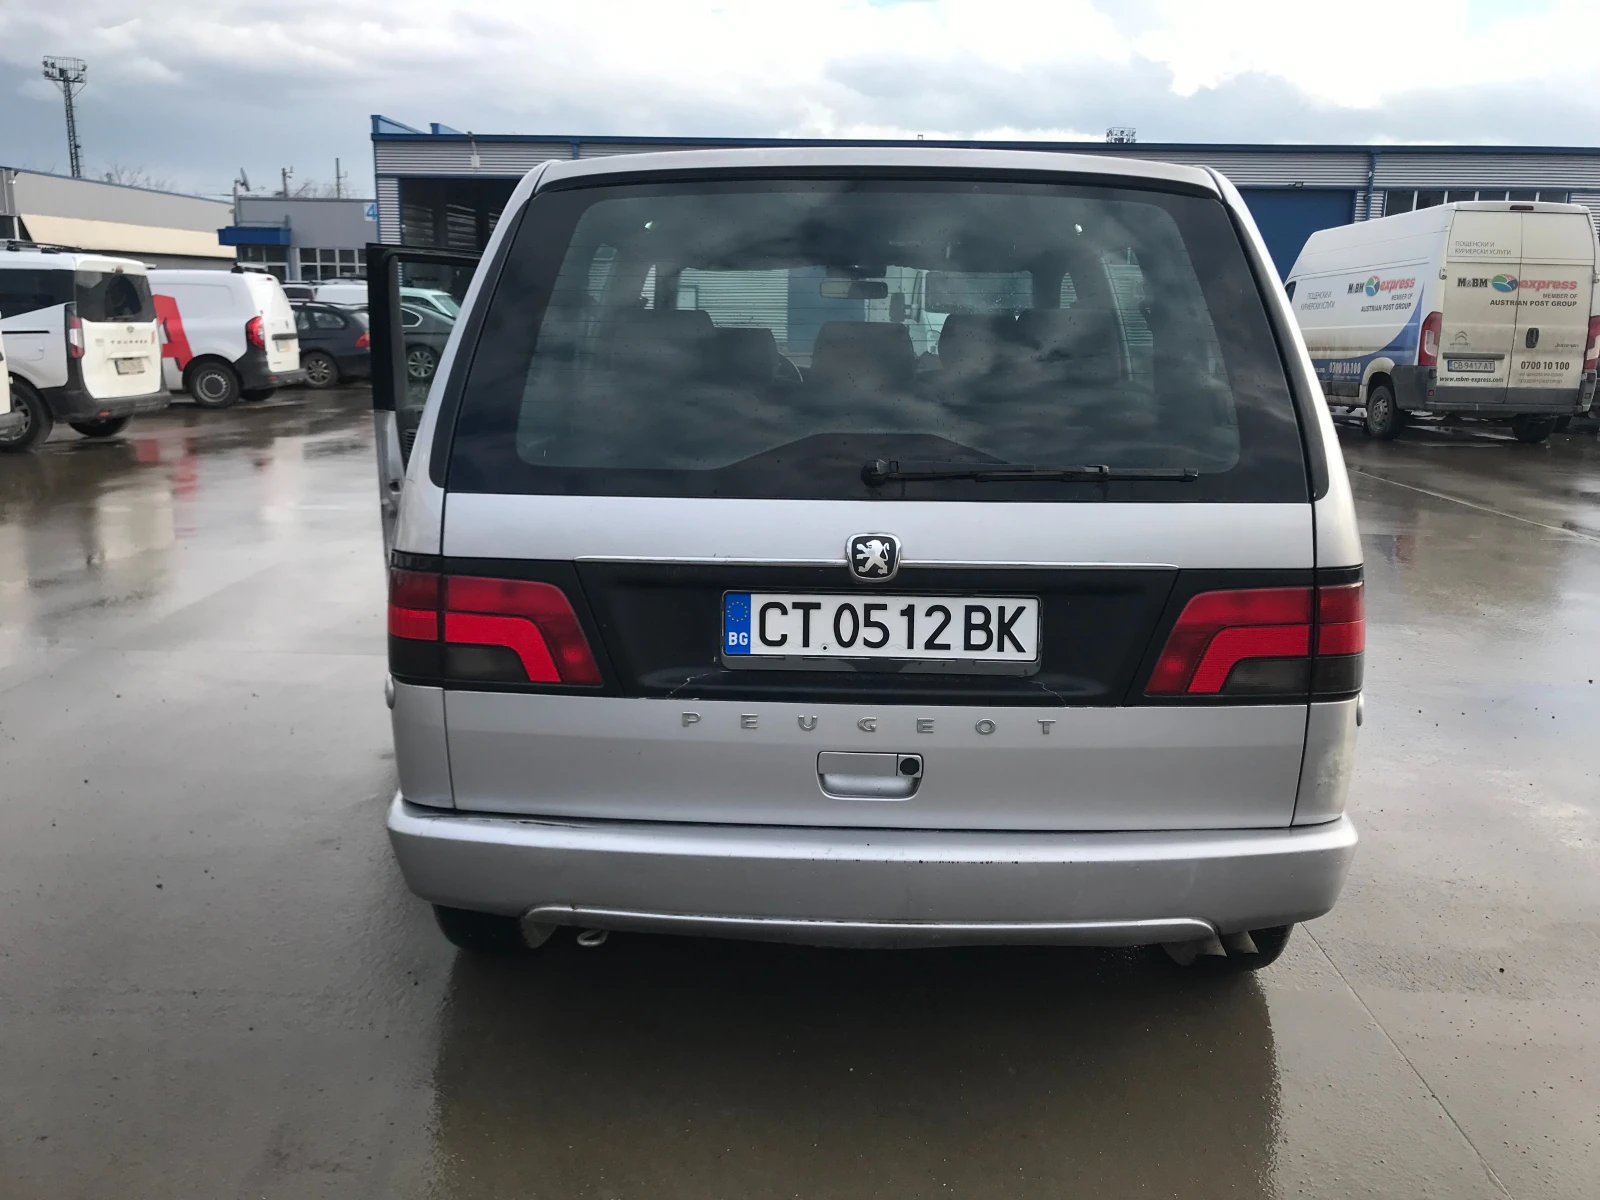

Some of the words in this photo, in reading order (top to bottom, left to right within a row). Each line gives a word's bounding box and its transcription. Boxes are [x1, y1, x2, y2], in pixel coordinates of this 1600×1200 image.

[1380, 277, 1416, 293] express
[1519, 279, 1578, 292] express
[1360, 304, 1382, 313] AUSTRIAN
[1382, 303, 1394, 311] POST
[1395, 302, 1412, 311] GROUP
[1489, 299, 1528, 307] AUSTRIAN
[1551, 300, 1578, 308] GROUP
[1328, 362, 1342, 374] 0700
[1342, 362, 1350, 374] 10
[1350, 362, 1361, 374] 100
[1520, 361, 1541, 370] 0700
[1542, 361, 1553, 370] 10
[1555, 361, 1570, 371] 100
[1439, 376, 1504, 384] www.mbm-express.com
[759, 601, 822, 648] CT
[833, 602, 953, 651] 0512
[963, 604, 1027, 653] BK
[728, 631, 749, 646] BG
[681, 711, 1057, 735] PEUGEOT
